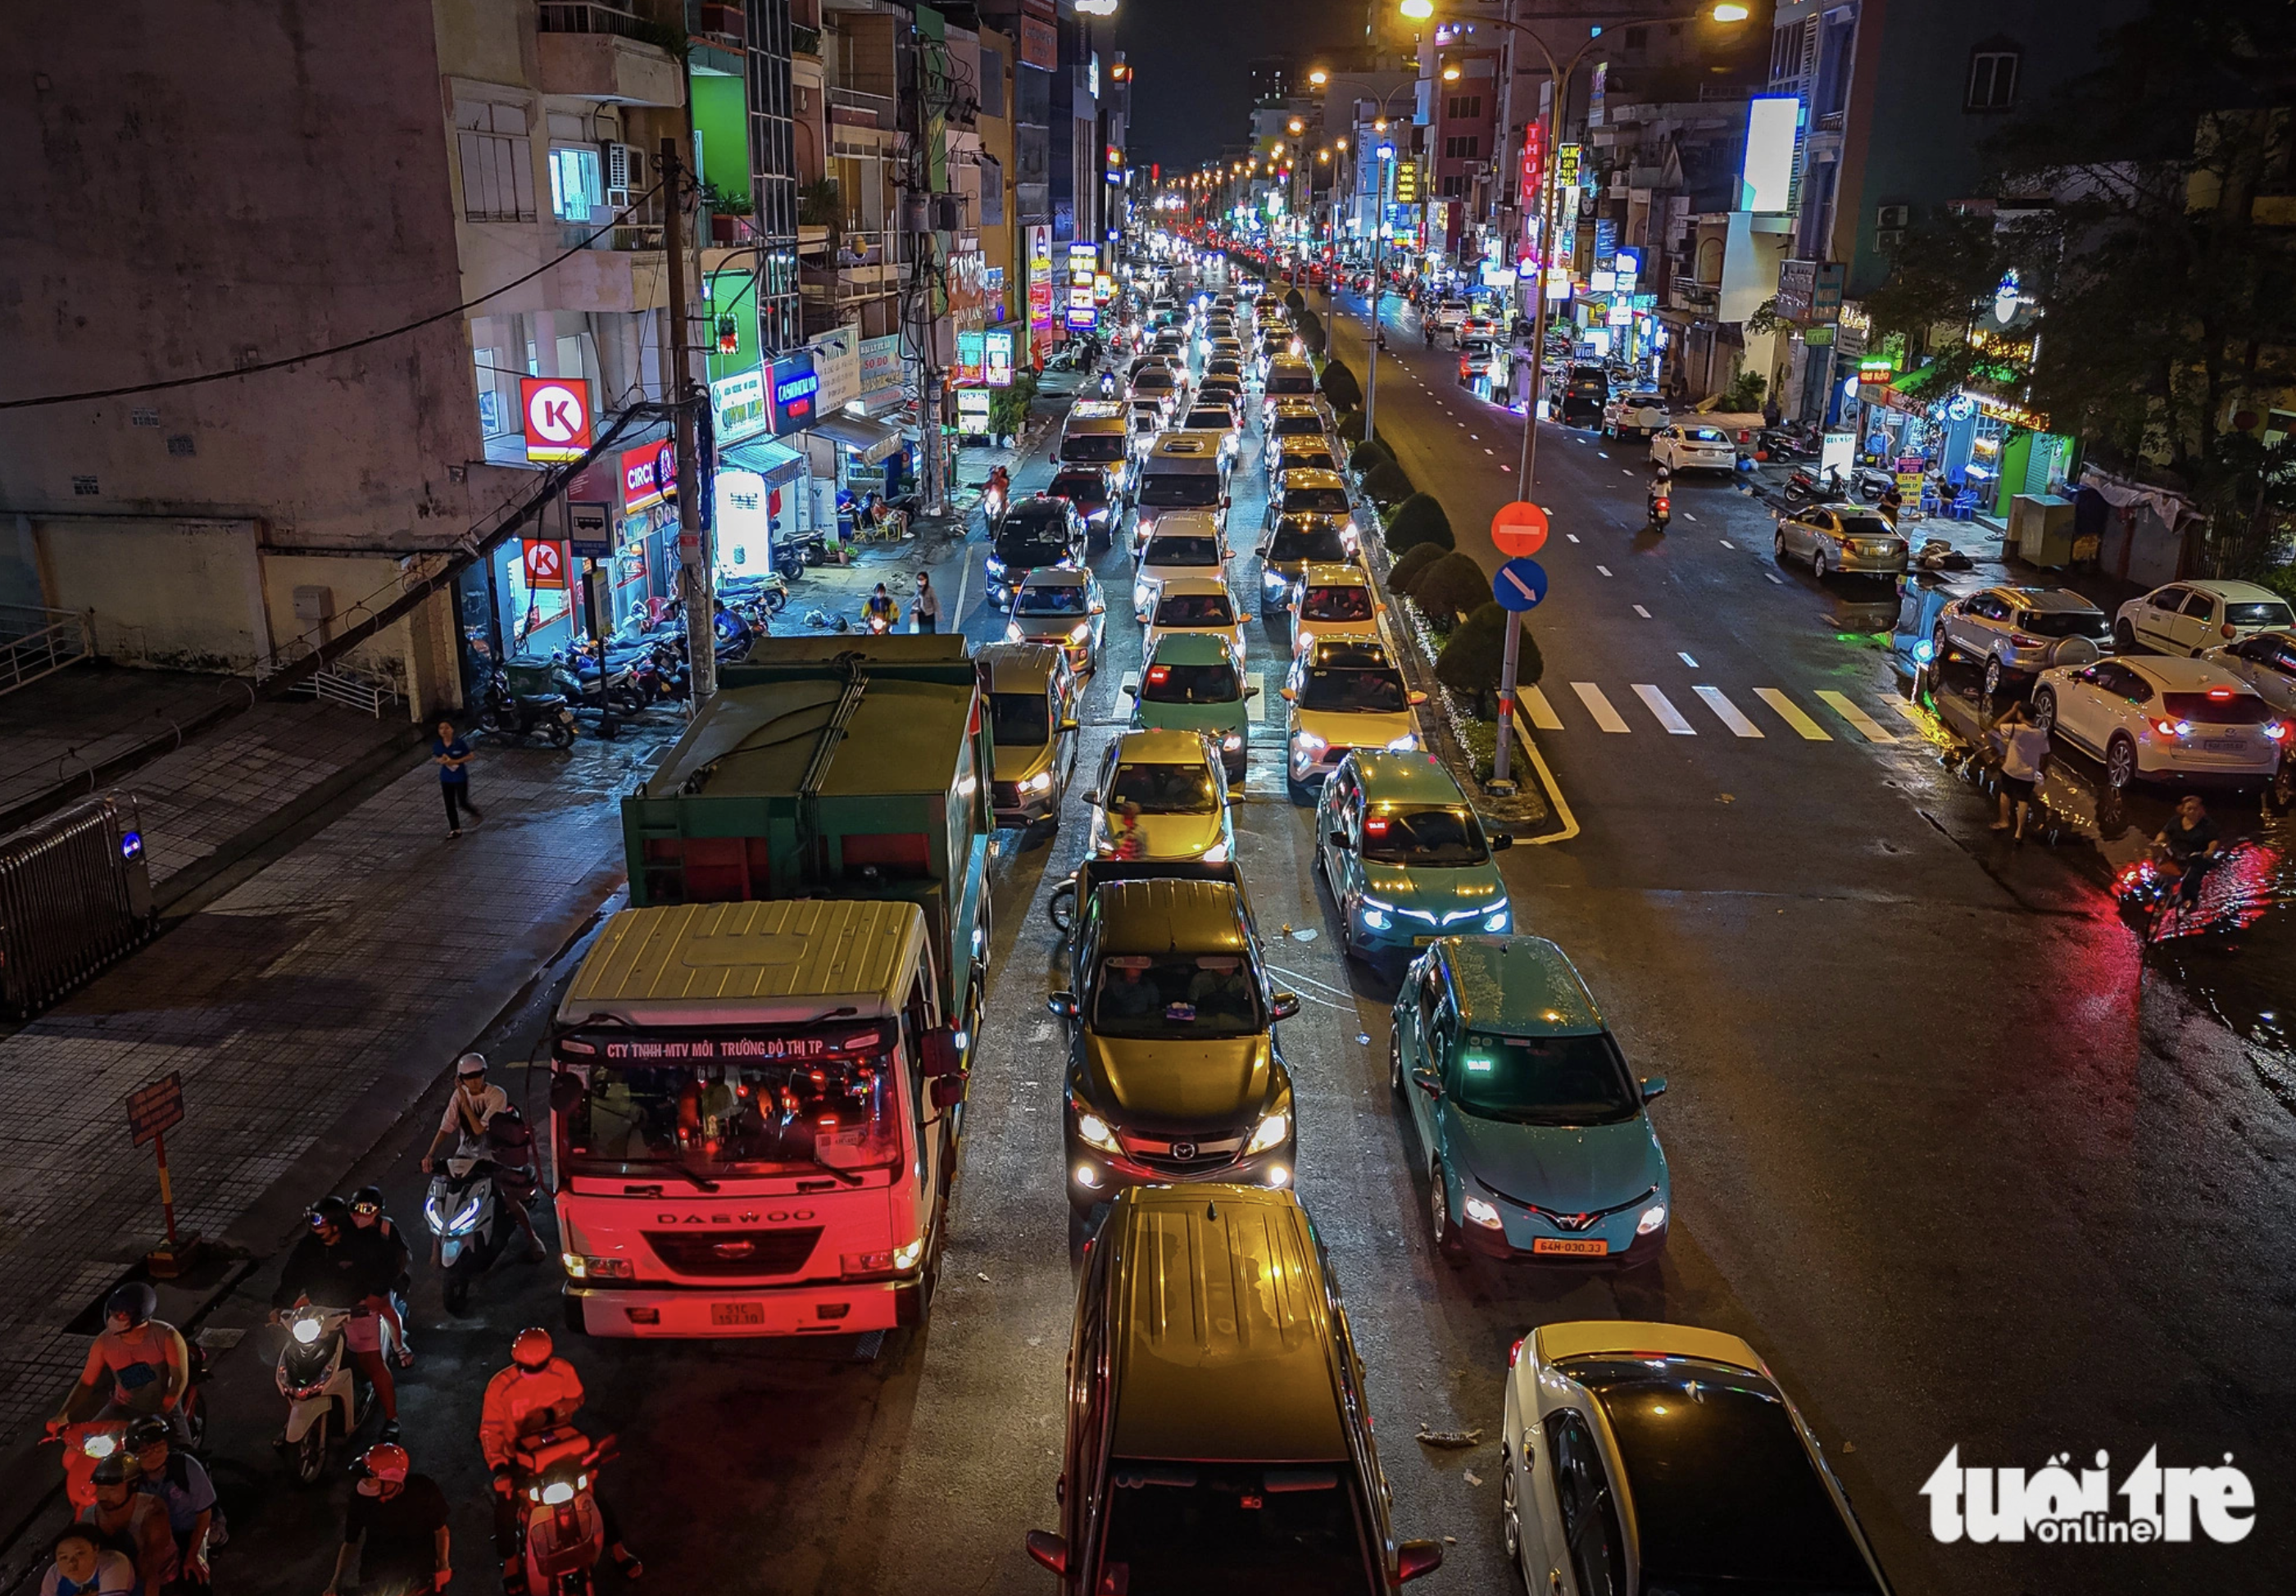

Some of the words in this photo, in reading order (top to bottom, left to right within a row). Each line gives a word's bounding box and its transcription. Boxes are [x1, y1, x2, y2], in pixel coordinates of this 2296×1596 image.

[627, 460, 656, 491] CIRCL
[607, 1043, 628, 1058] CTY
[632, 1043, 661, 1058] TNHH
[665, 1042, 689, 1057] MTV
[692, 1040, 714, 1057] MÔI
[720, 1037, 765, 1056] TRƯỜNG
[787, 1040, 806, 1057] THỊ
[809, 1039, 824, 1054] TP
[656, 1209, 817, 1225] DAEWOO
